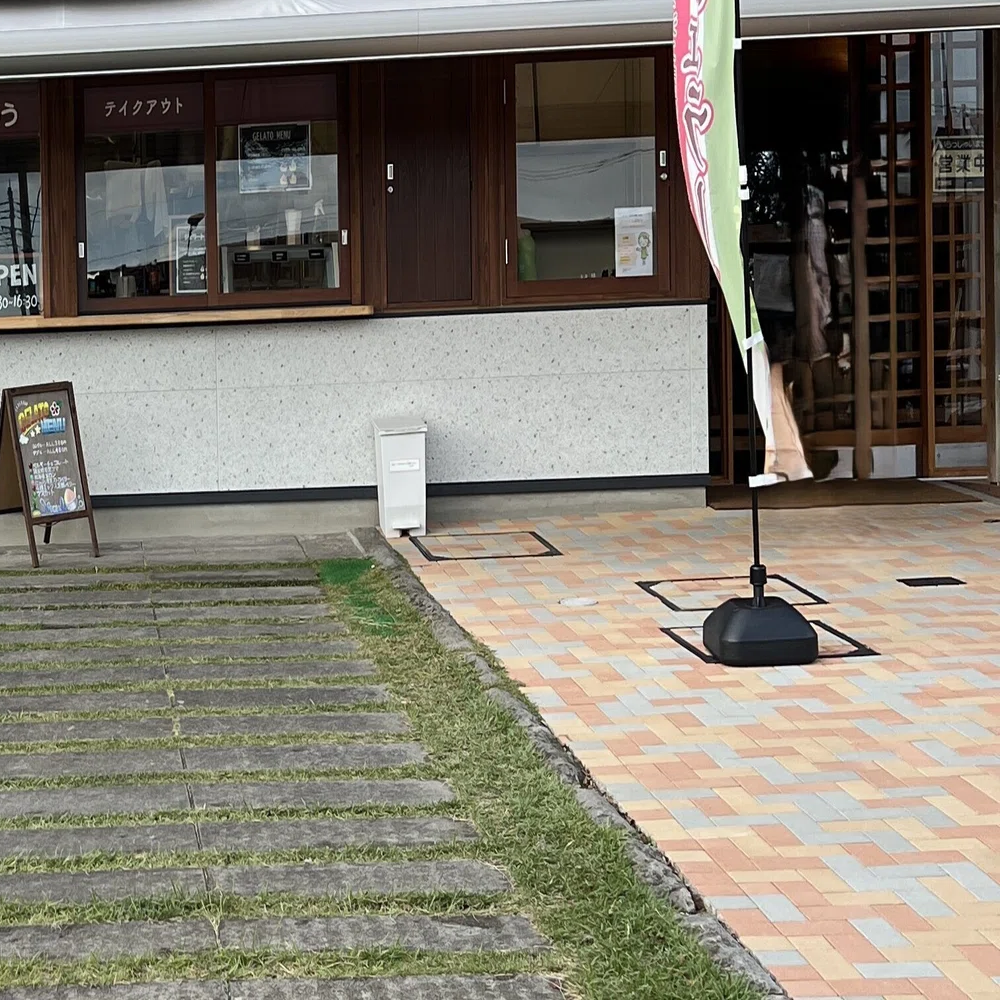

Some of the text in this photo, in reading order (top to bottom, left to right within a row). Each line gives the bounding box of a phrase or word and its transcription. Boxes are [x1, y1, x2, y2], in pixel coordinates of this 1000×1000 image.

[104, 96, 184, 118] テイクアウト
[252, 130, 292, 142] GELATO MENU
